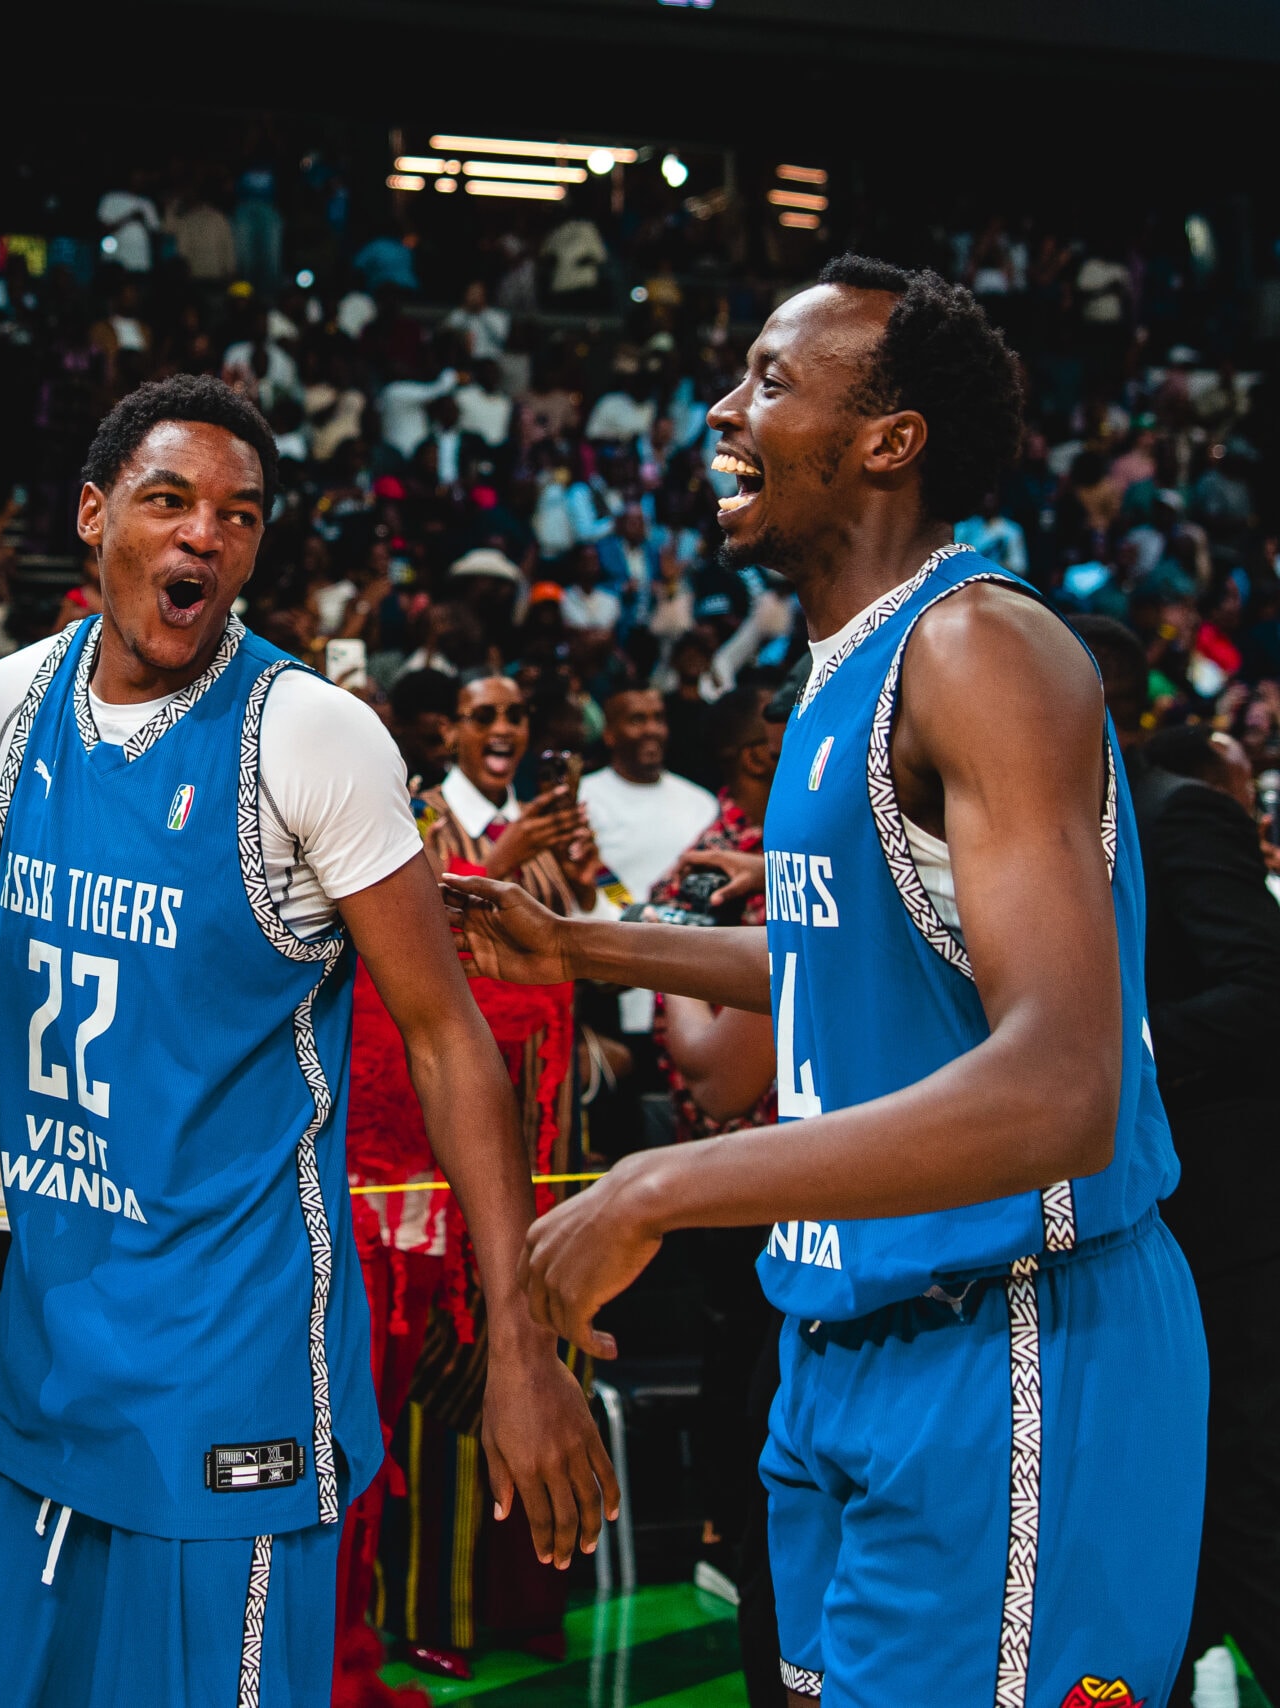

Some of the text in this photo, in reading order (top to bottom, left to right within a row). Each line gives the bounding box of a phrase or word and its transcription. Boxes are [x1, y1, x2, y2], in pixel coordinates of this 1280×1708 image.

[67, 868, 184, 949] TIGERS
[28, 938, 119, 1119] 22
[768, 952, 823, 1120] 4
[25, 1113, 109, 1172] VISIT
[0, 1150, 148, 1226] WANDA
[766, 1220, 842, 1271] NDA
[267, 1446, 285, 1463] XL
